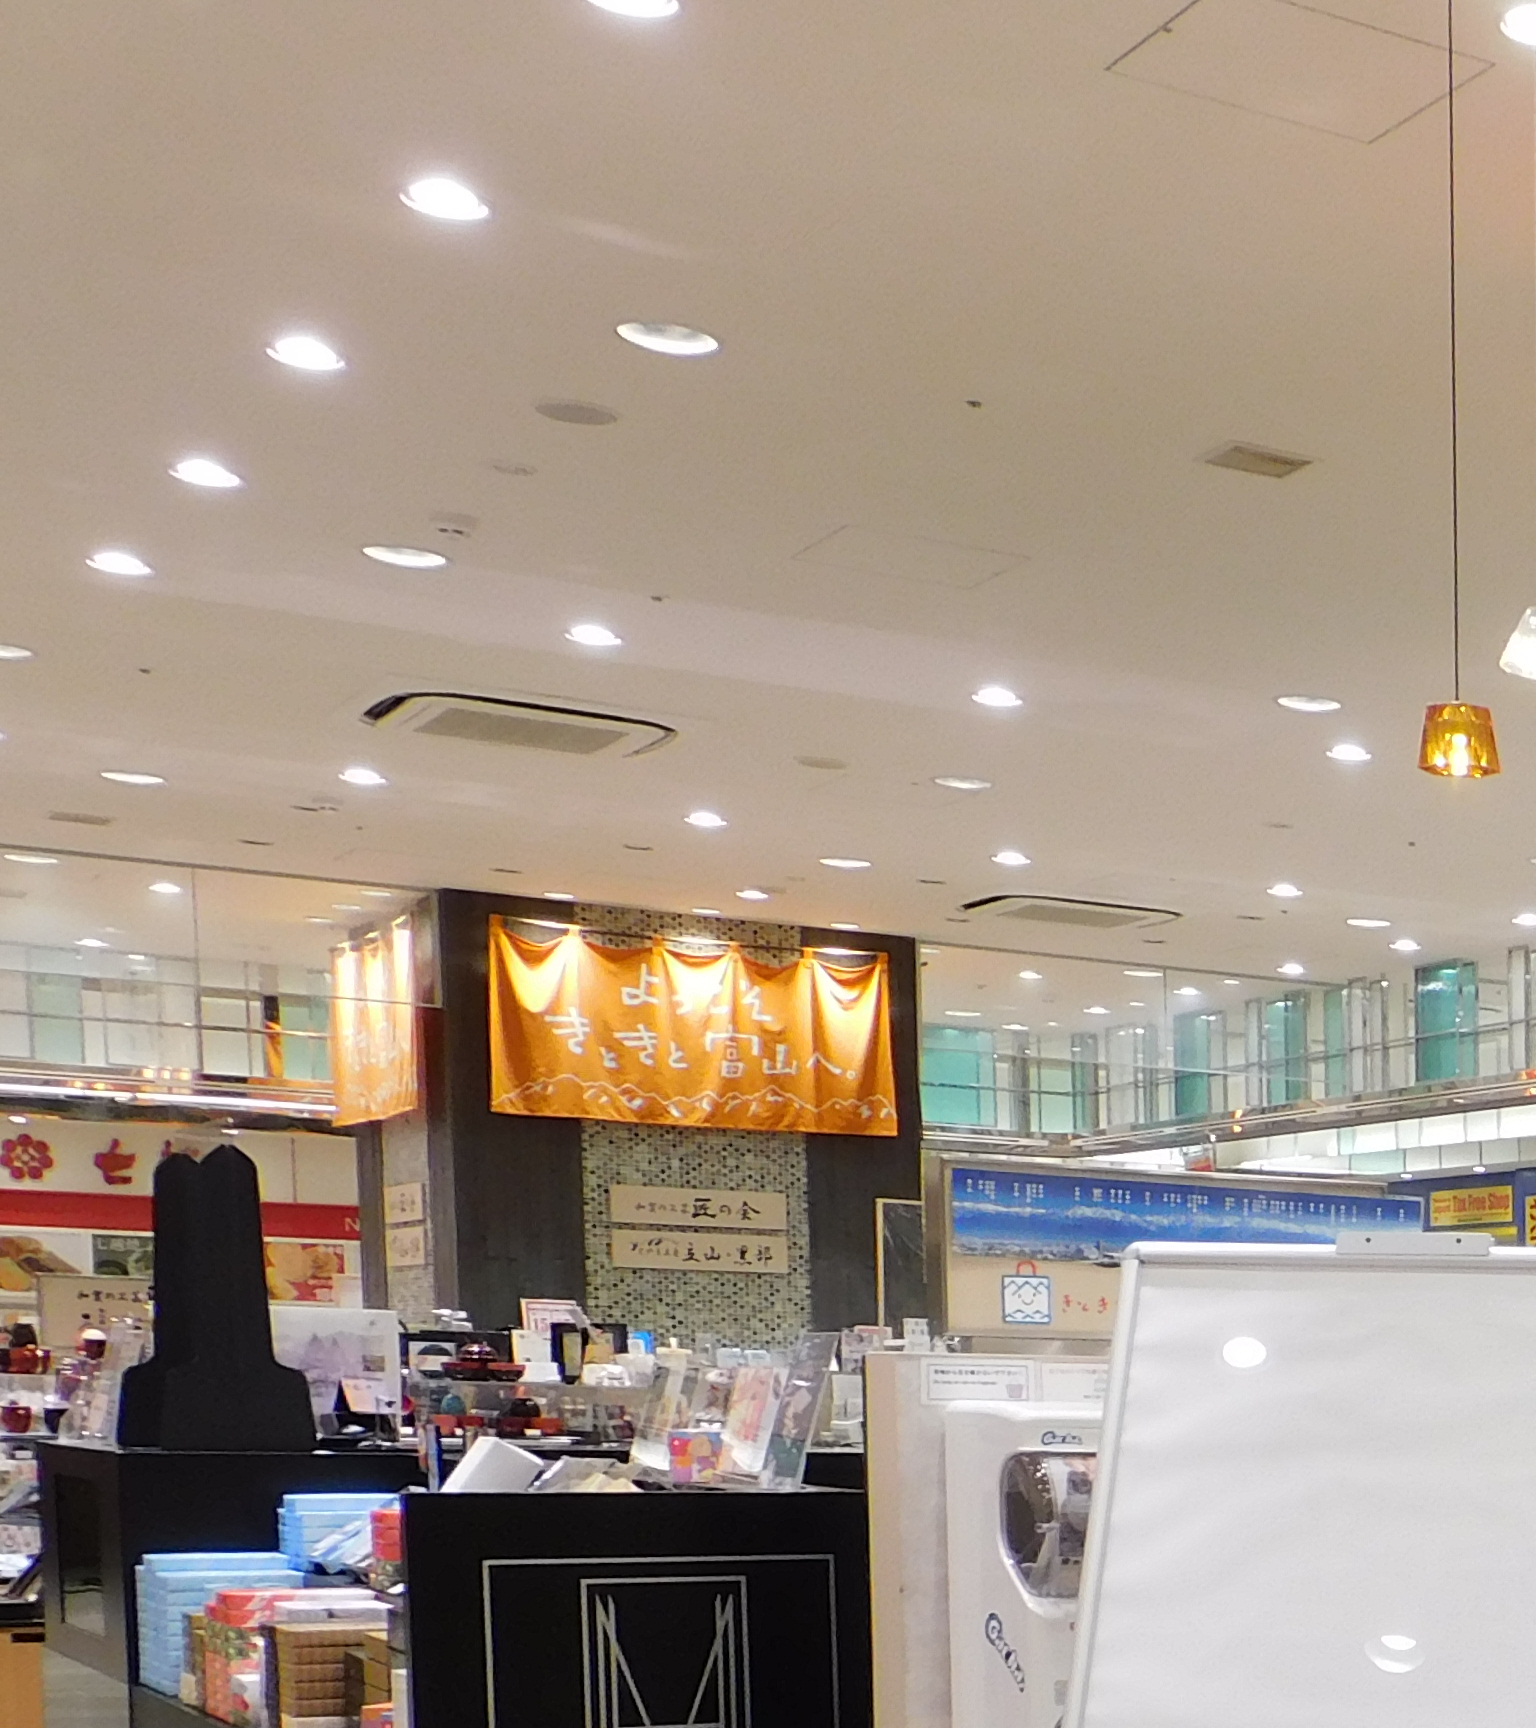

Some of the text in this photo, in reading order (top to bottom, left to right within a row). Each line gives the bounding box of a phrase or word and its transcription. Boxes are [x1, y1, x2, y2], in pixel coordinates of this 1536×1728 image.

[621, 963, 775, 1024] よそ
[544, 1007, 857, 1080] きときと富山へ。
